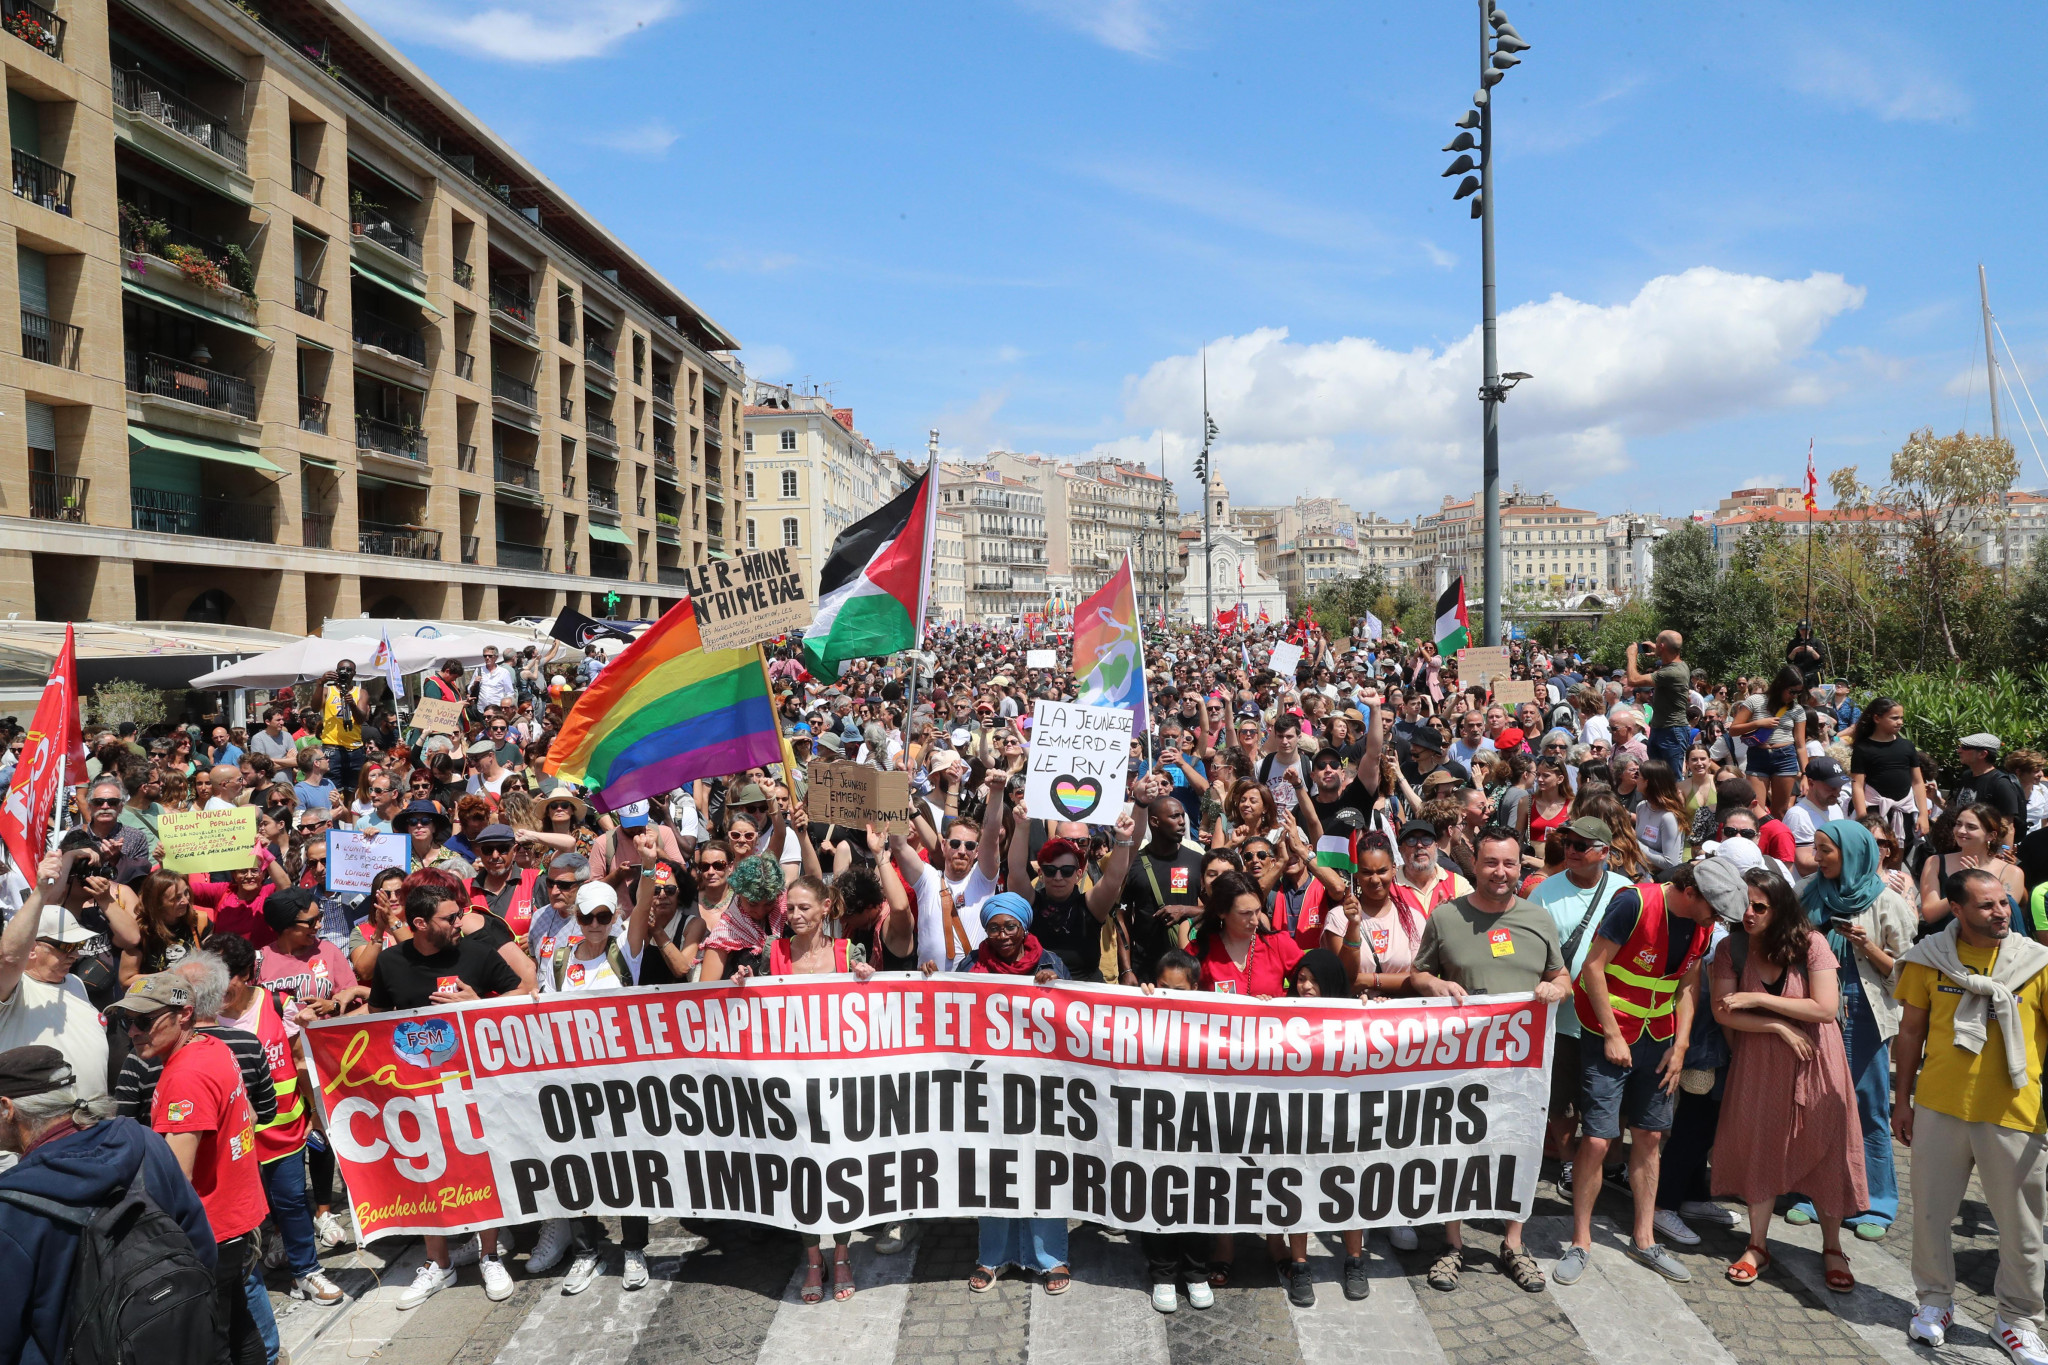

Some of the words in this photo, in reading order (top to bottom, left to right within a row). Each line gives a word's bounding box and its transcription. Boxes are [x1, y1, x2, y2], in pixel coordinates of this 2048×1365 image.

[685, 565, 712, 597] LE
[767, 573, 804, 605] PAS
[1039, 705, 1067, 728] LA
[1075, 708, 1134, 733] JEUNESSE
[1037, 731, 1121, 752] EMMERDE
[1034, 753, 1058, 772] LE
[1071, 756, 1105, 776] RN
[815, 769, 834, 787] LA
[837, 771, 867, 791] JEUNESSE
[830, 790, 866, 805] EMMERDE
[196, 810, 232, 820] NOUVEAU
[824, 804, 835, 818] LE
[839, 807, 861, 819] FRONT
[174, 823, 200, 832] FRONT
[210, 818, 247, 828] POPULAIRE
[345, 853, 358, 861] DES
[406, 1029, 445, 1047] FSM
[475, 1007, 627, 1072] CONTRE
[629, 1003, 673, 1058] LE
[675, 992, 926, 1053] CAPITALISME
[933, 991, 977, 1047] ET
[985, 991, 1056, 1054] SES
[1066, 999, 1317, 1073] SERVITEURS
[1322, 1009, 1533, 1073] FASCISTES
[539, 1073, 797, 1143] OPPOSONS
[806, 1059, 989, 1144] L'UNITÉ
[1001, 1073, 1098, 1143] DES
[1110, 1082, 1490, 1156] TRAVAILLEURS
[330, 1070, 490, 1183] cgt
[510, 1149, 675, 1215] POUR
[684, 1147, 940, 1225] IMPOSER
[958, 1148, 1019, 1211] LE
[1034, 1149, 1304, 1227] PROGRÈS
[1318, 1154, 1522, 1224] SOCIAL
[355, 1194, 417, 1230] Bouches
[419, 1194, 437, 1215] du
[438, 1183, 492, 1211] Rhône
